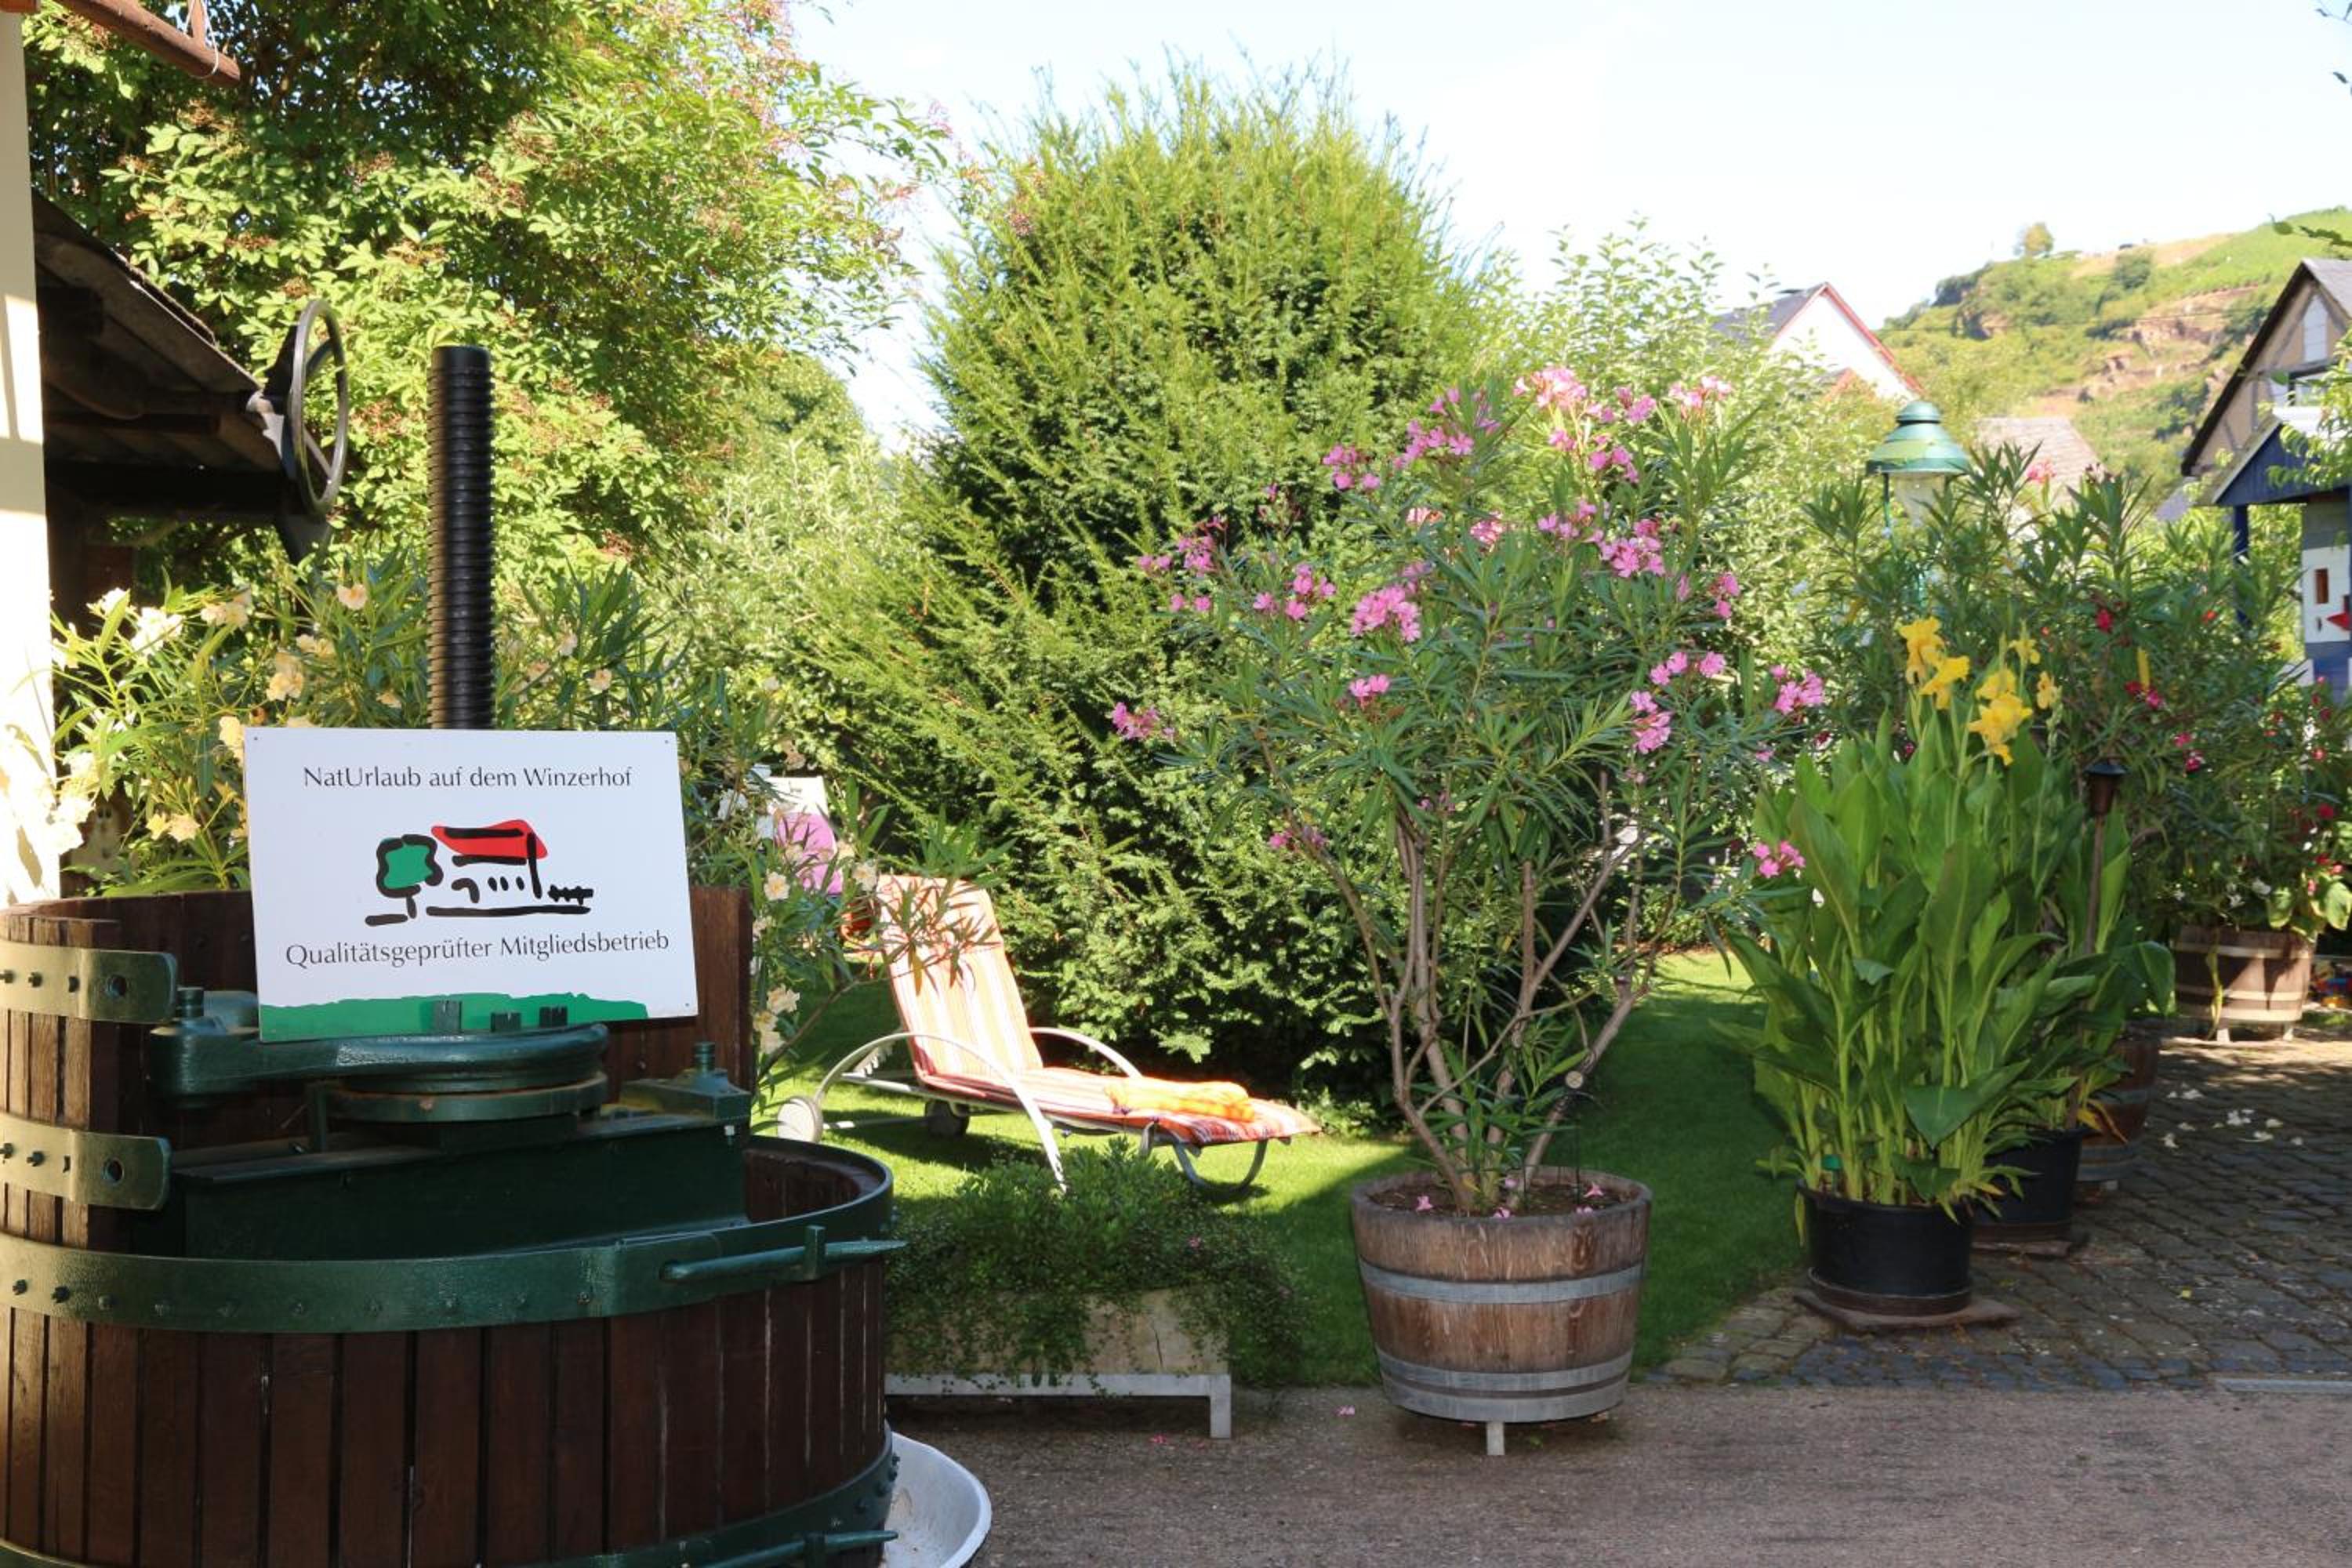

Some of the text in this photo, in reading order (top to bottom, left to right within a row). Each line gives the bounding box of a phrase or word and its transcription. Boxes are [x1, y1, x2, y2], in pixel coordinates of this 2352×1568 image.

[303, 766, 632, 787] NatUrlaub auf dem Winzerhof
[285, 929, 669, 969] Qualitätsgeprüfter Mitgliedsbetrieb
